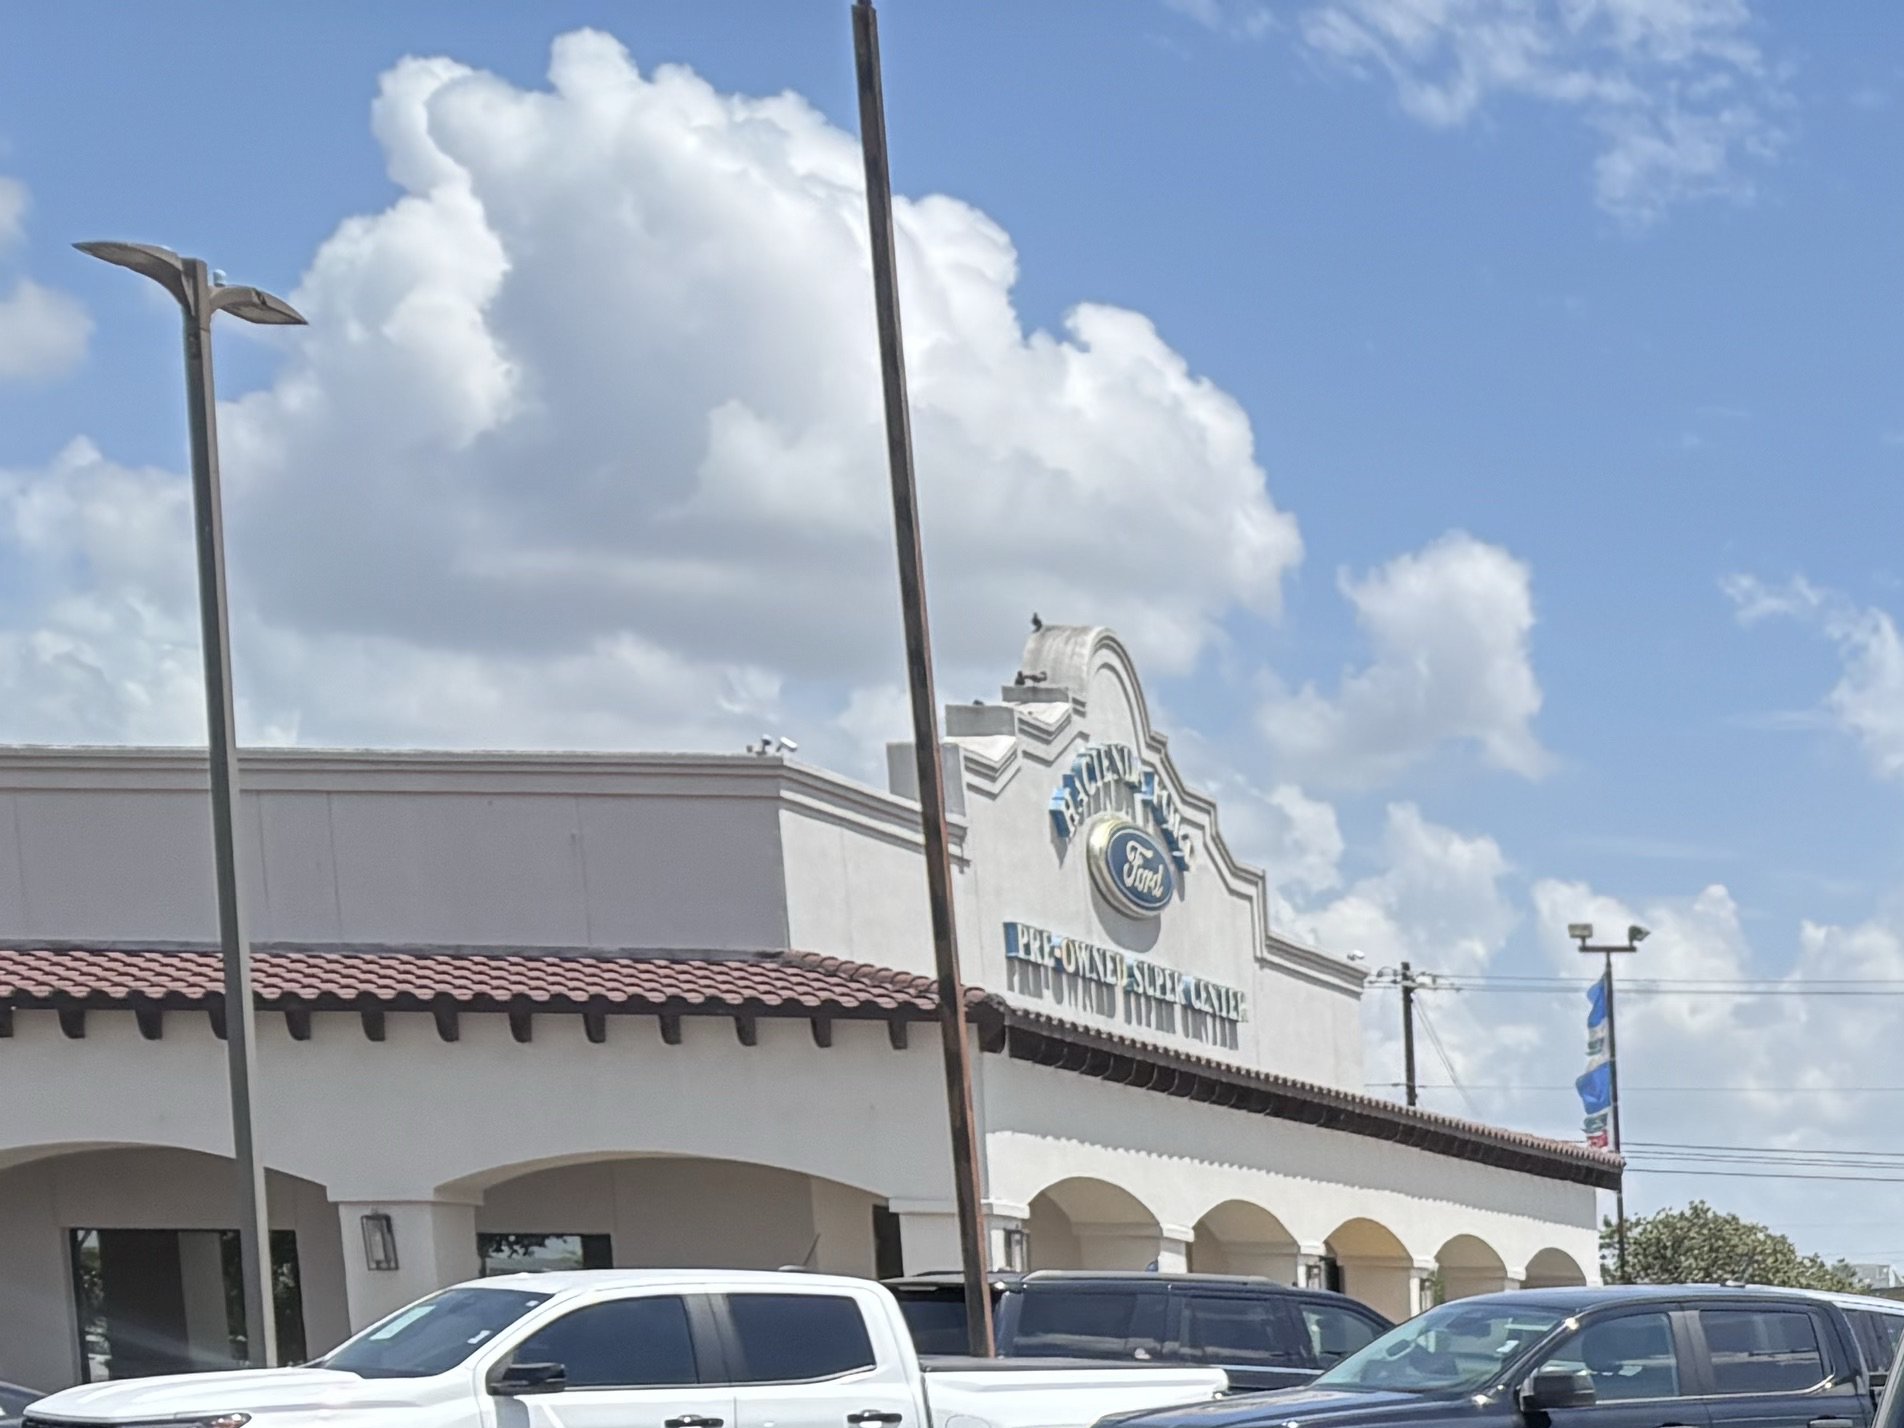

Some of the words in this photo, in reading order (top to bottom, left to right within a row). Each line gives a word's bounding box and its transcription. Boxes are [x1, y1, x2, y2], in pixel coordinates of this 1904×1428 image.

[1123, 840, 1165, 898] Ford
[1013, 922, 1128, 987] PRE-OWNED
[1132, 959, 1187, 1004] SUPER
[1189, 976, 1248, 1022] CENTER
